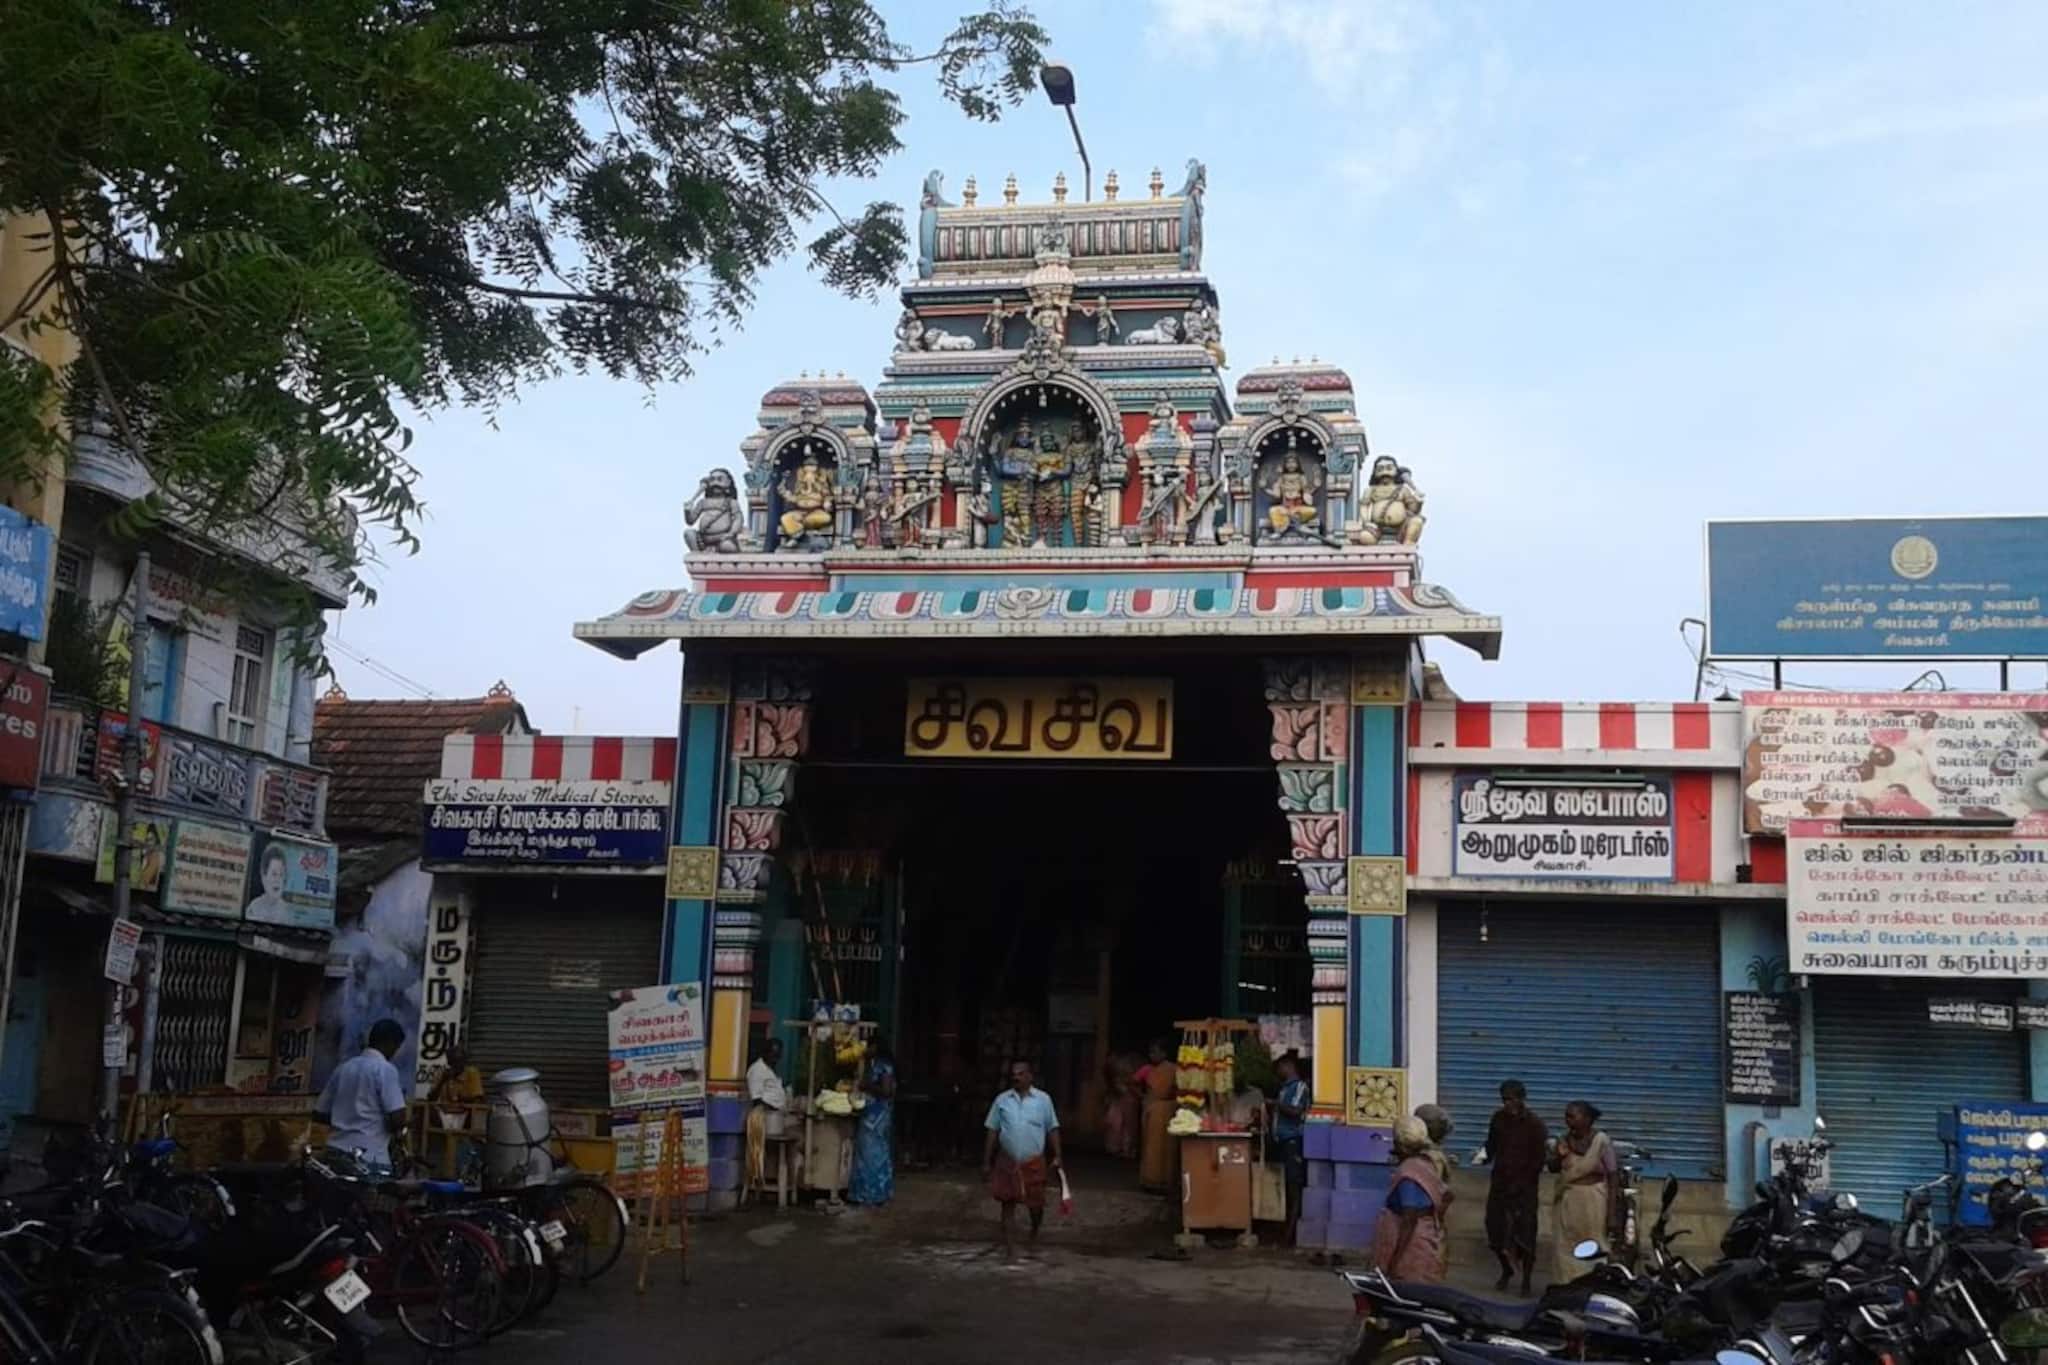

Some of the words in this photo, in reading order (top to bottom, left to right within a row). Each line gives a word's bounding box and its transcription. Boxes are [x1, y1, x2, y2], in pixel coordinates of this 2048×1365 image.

[430, 786, 458, 803] The
[462, 787, 528, 804] Sivakasi
[532, 787, 597, 804] Medical
[430, 805, 498, 829] சிவகாசி
[500, 805, 581, 833] மெடிக்கல்
[1461, 829, 1576, 862] ஆறுமுகம்
[1580, 829, 1670, 861] டிரேடர்ஸ்
[1805, 844, 1854, 865] ஜில்
[1863, 844, 1911, 865] ஜில்
[1809, 867, 1904, 882] கோக்கோ
[1911, 867, 2000, 883] சாக்லேட்
[1815, 887, 1880, 904] காப்பி
[1888, 887, 1987, 905] சாக்லேட்
[1795, 909, 1860, 925] ஜெல்லி
[1866, 909, 1946, 926] சாக்லேட்
[1806, 929, 1871, 945] ஜெல்லி
[1802, 951, 1927, 970] சுவையான
